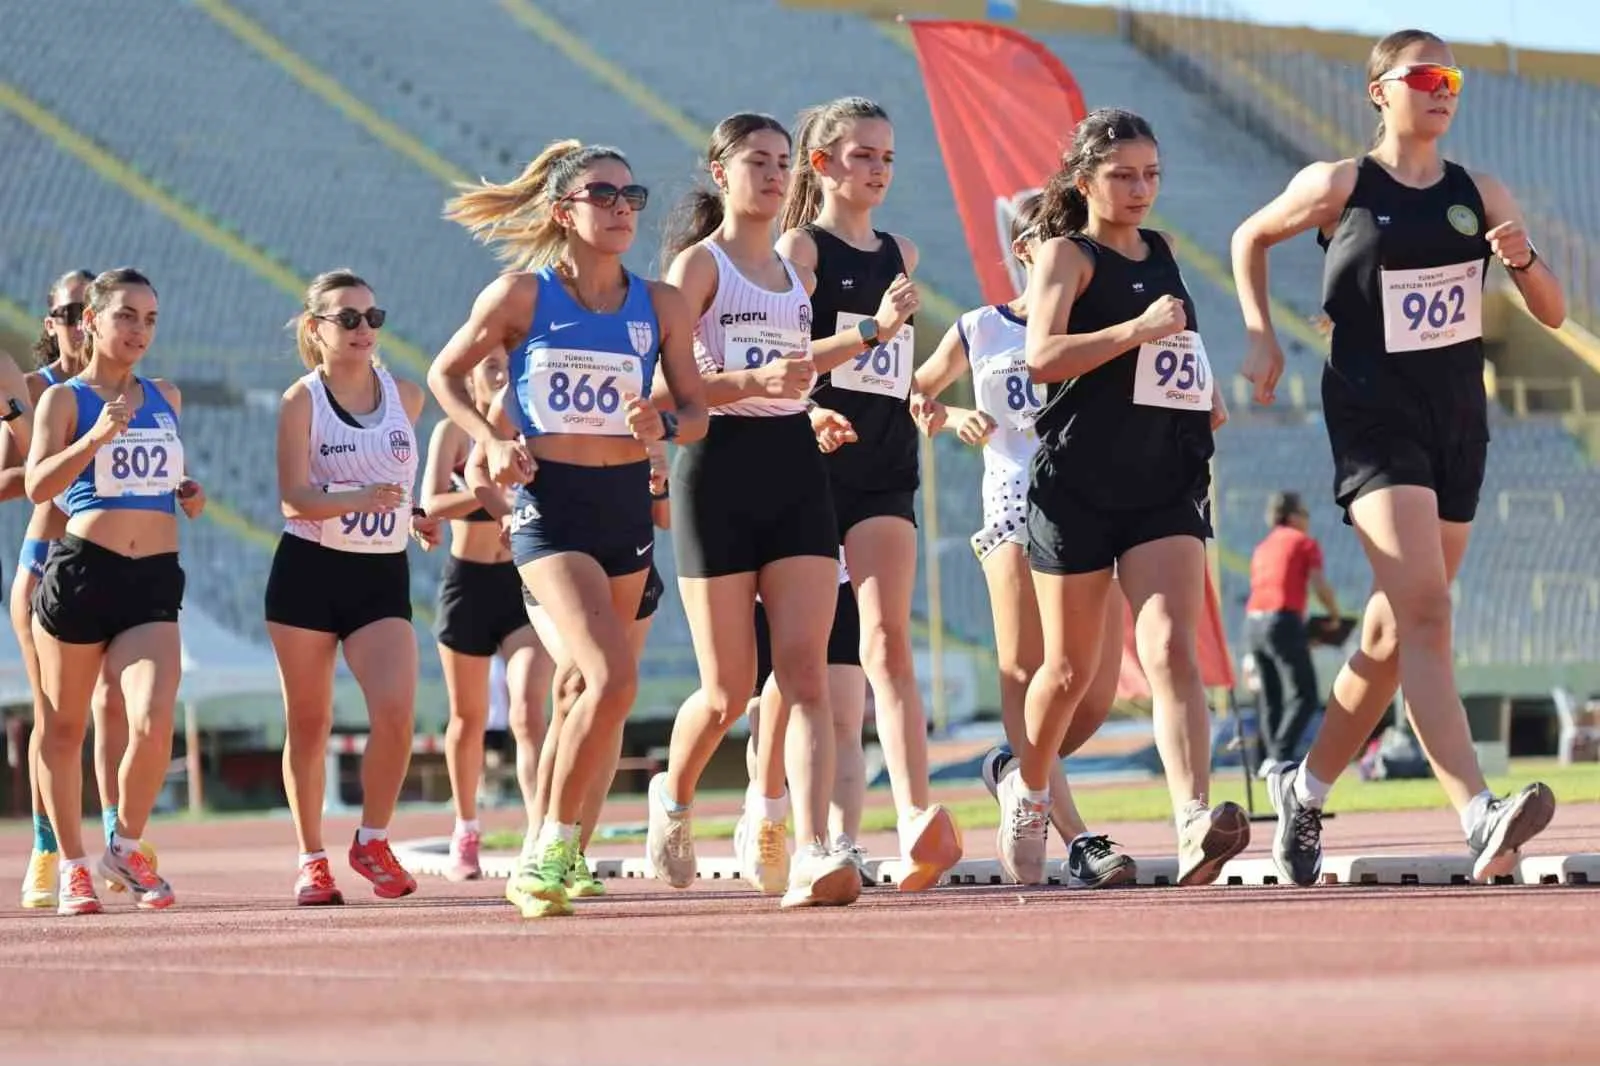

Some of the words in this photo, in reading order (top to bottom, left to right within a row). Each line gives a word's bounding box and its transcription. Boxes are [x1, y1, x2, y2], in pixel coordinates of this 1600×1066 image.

[735, 311, 767, 323] raru
[1402, 284, 1466, 331] 962
[1154, 350, 1206, 391] 950
[548, 371, 620, 414] 866
[111, 445, 169, 479] 802
[330, 444, 356, 454] raru
[340, 511, 396, 537] 900
